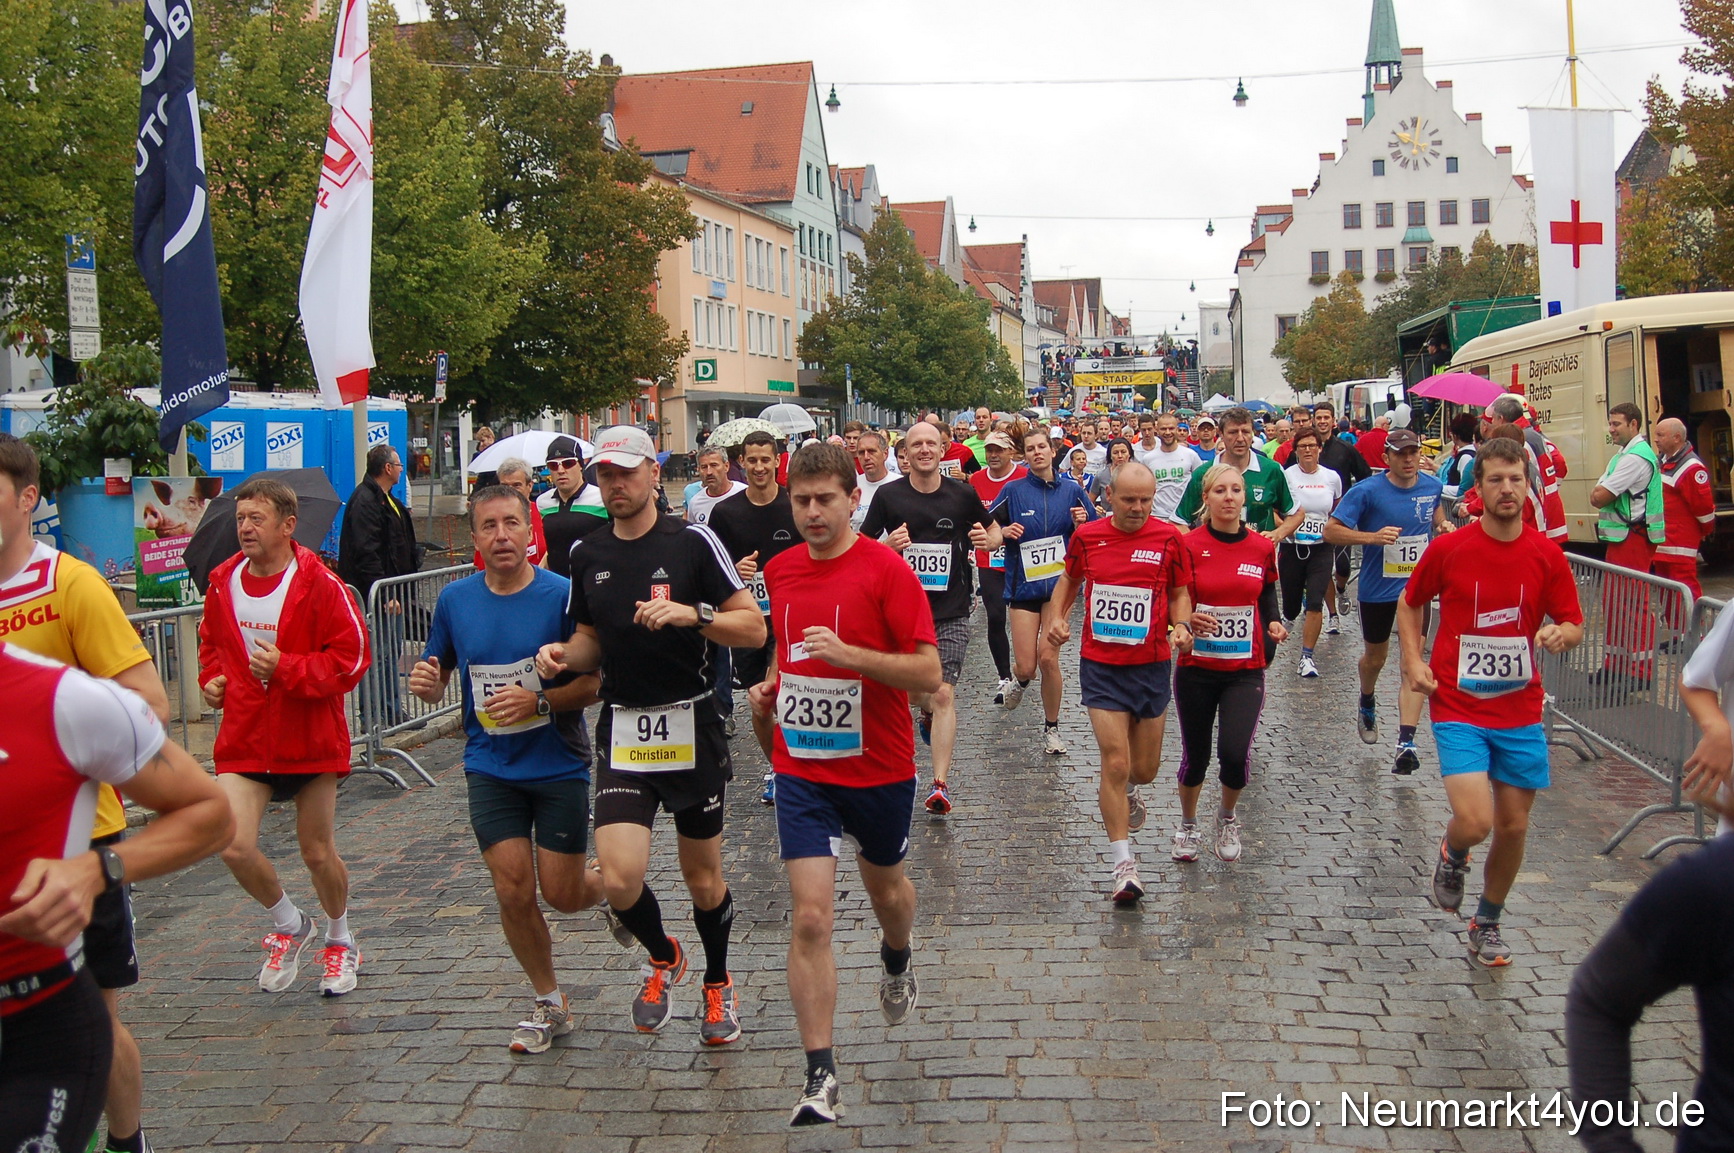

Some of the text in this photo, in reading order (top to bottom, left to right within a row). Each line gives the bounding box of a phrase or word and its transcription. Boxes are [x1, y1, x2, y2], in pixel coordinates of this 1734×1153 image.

[698, 362, 714, 378] D
[1529, 352, 1579, 381] Bayerisches
[1102, 374, 1134, 383] START
[1528, 382, 1552, 402] Rotes
[144, 550, 167, 562] BEIDE
[1031, 546, 1056, 565] 577
[1131, 550, 1162, 560] JURA
[1399, 546, 1417, 562] 15
[908, 555, 947, 572] 3039
[1237, 563, 1262, 574] JURA
[919, 576, 936, 584] Silvio
[1096, 599, 1145, 623] 2560
[1488, 612, 1508, 622] DEHN
[1103, 626, 1132, 636] Herbert
[1206, 642, 1238, 652] Ramona
[1462, 641, 1486, 650] PARTL
[1466, 652, 1523, 678] 2331
[489, 670, 523, 679] Neumarkt
[782, 681, 845, 695] PARTL Neumarkt
[1475, 682, 1512, 692] Raphael
[783, 695, 852, 728] 2332
[637, 714, 669, 742] 94
[798, 734, 834, 747] Martin
[629, 749, 676, 761] Christian
[602, 787, 641, 795] Elektronik
